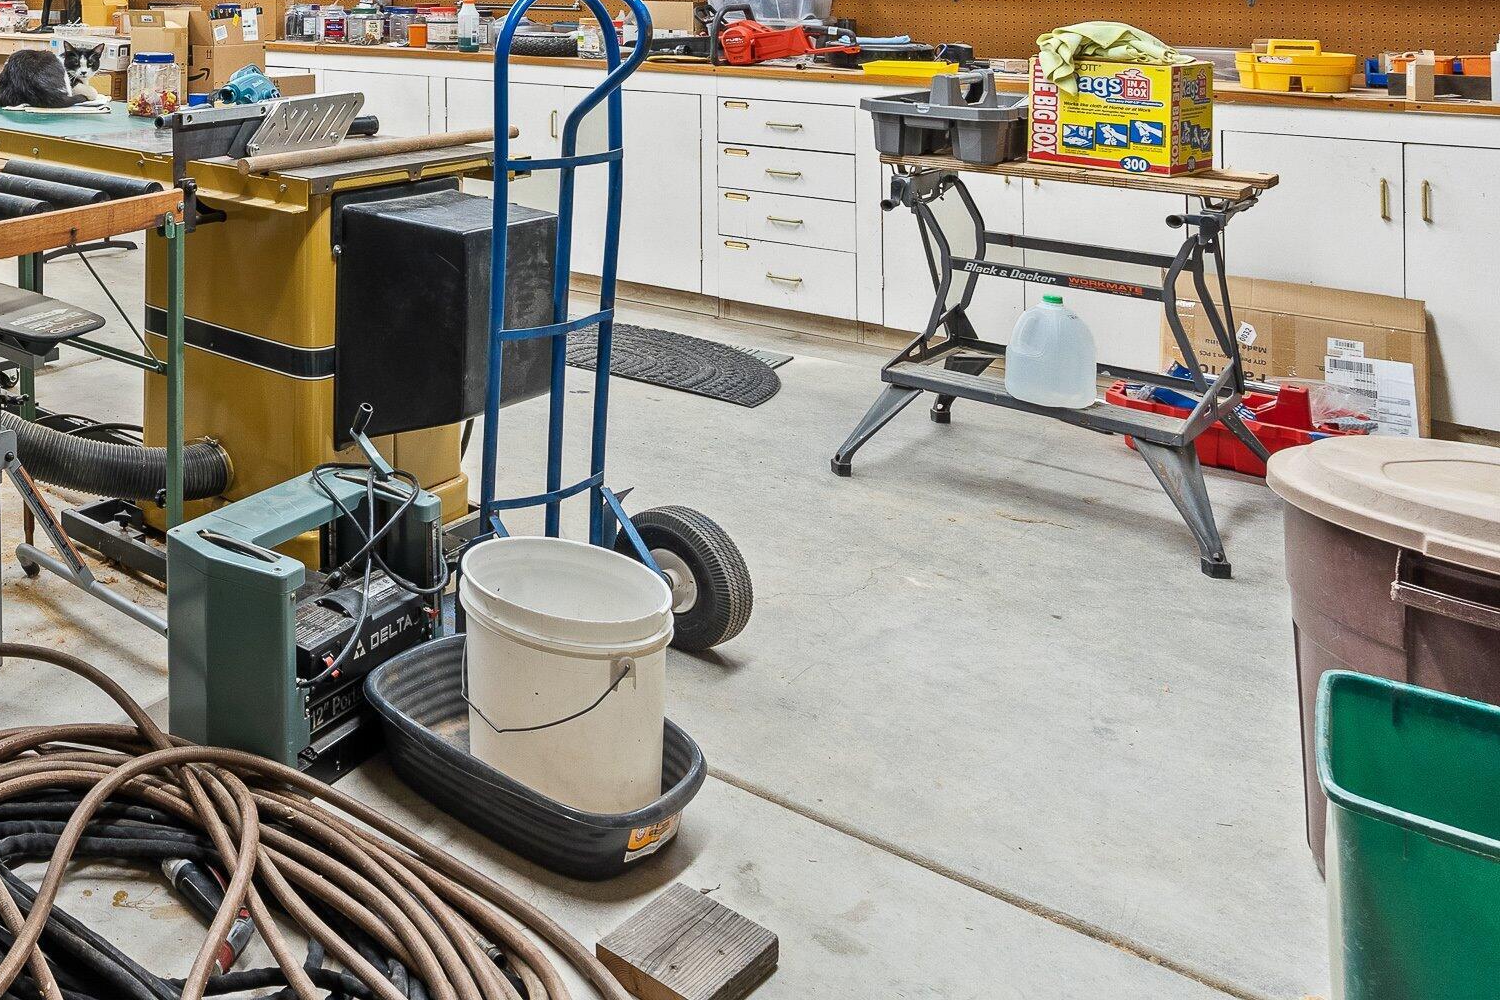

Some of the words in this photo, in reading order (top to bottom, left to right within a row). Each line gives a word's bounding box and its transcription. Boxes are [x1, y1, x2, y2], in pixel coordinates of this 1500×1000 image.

[1076, 75, 1123, 97] ags
[1127, 80, 1138, 88] IN
[1127, 88, 1147, 98] BOX
[1032, 95, 1058, 120] BIG
[1032, 122, 1058, 154] BOX
[1123, 158, 1147, 171] 300
[964, 261, 998, 276] Black
[999, 269, 1008, 278] &
[1010, 269, 1057, 284] Decker
[1068, 276, 1144, 294] WORKMATE
[1241, 344, 1267, 354] Made
[370, 614, 414, 650] DELTA
